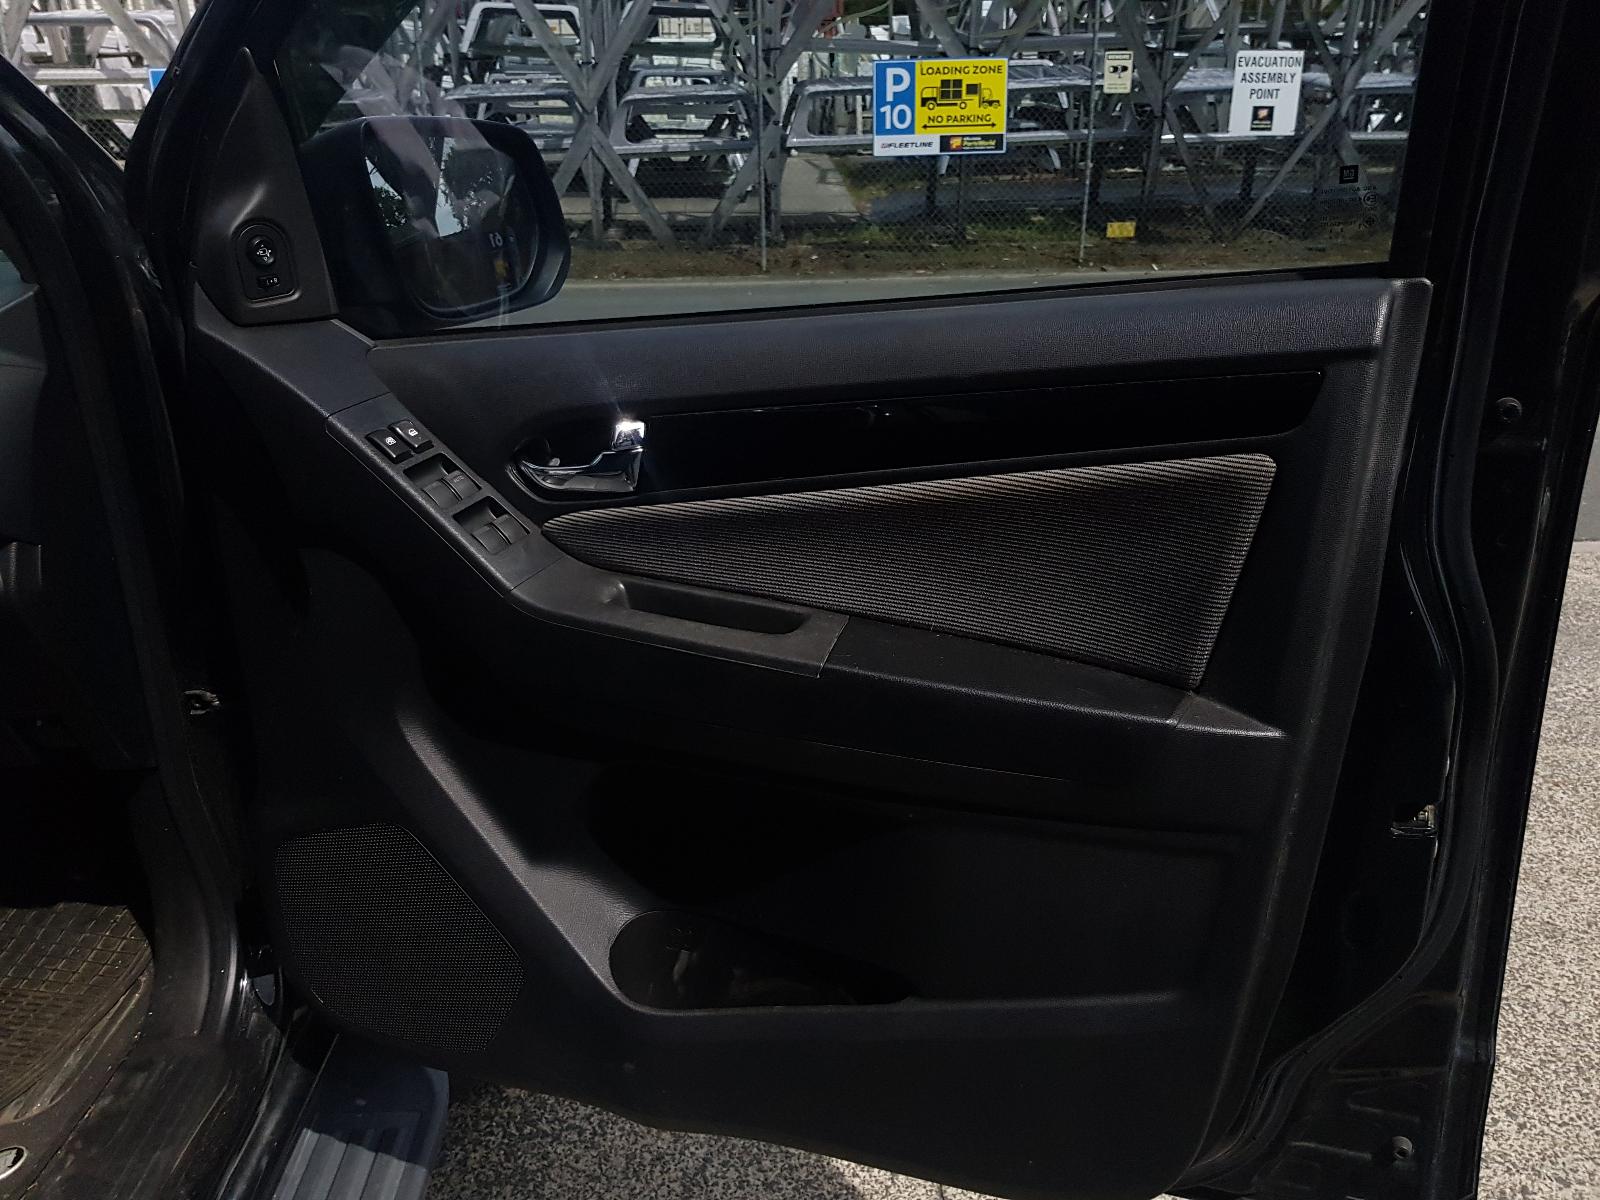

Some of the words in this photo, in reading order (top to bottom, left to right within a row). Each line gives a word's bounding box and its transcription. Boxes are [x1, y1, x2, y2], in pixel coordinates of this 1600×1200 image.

[1238, 56, 1302, 68] EVACUATION
[920, 65, 970, 76] LOADING
[972, 65, 1003, 75] ZONE
[1240, 72, 1297, 84] ASSEMBLY
[886, 67, 911, 102] P
[1249, 88, 1280, 100] POINT
[880, 104, 913, 130] 10
[928, 115, 944, 124] NO
[946, 114, 992, 124] PARKING
[888, 141, 934, 149] FLEETLINE
